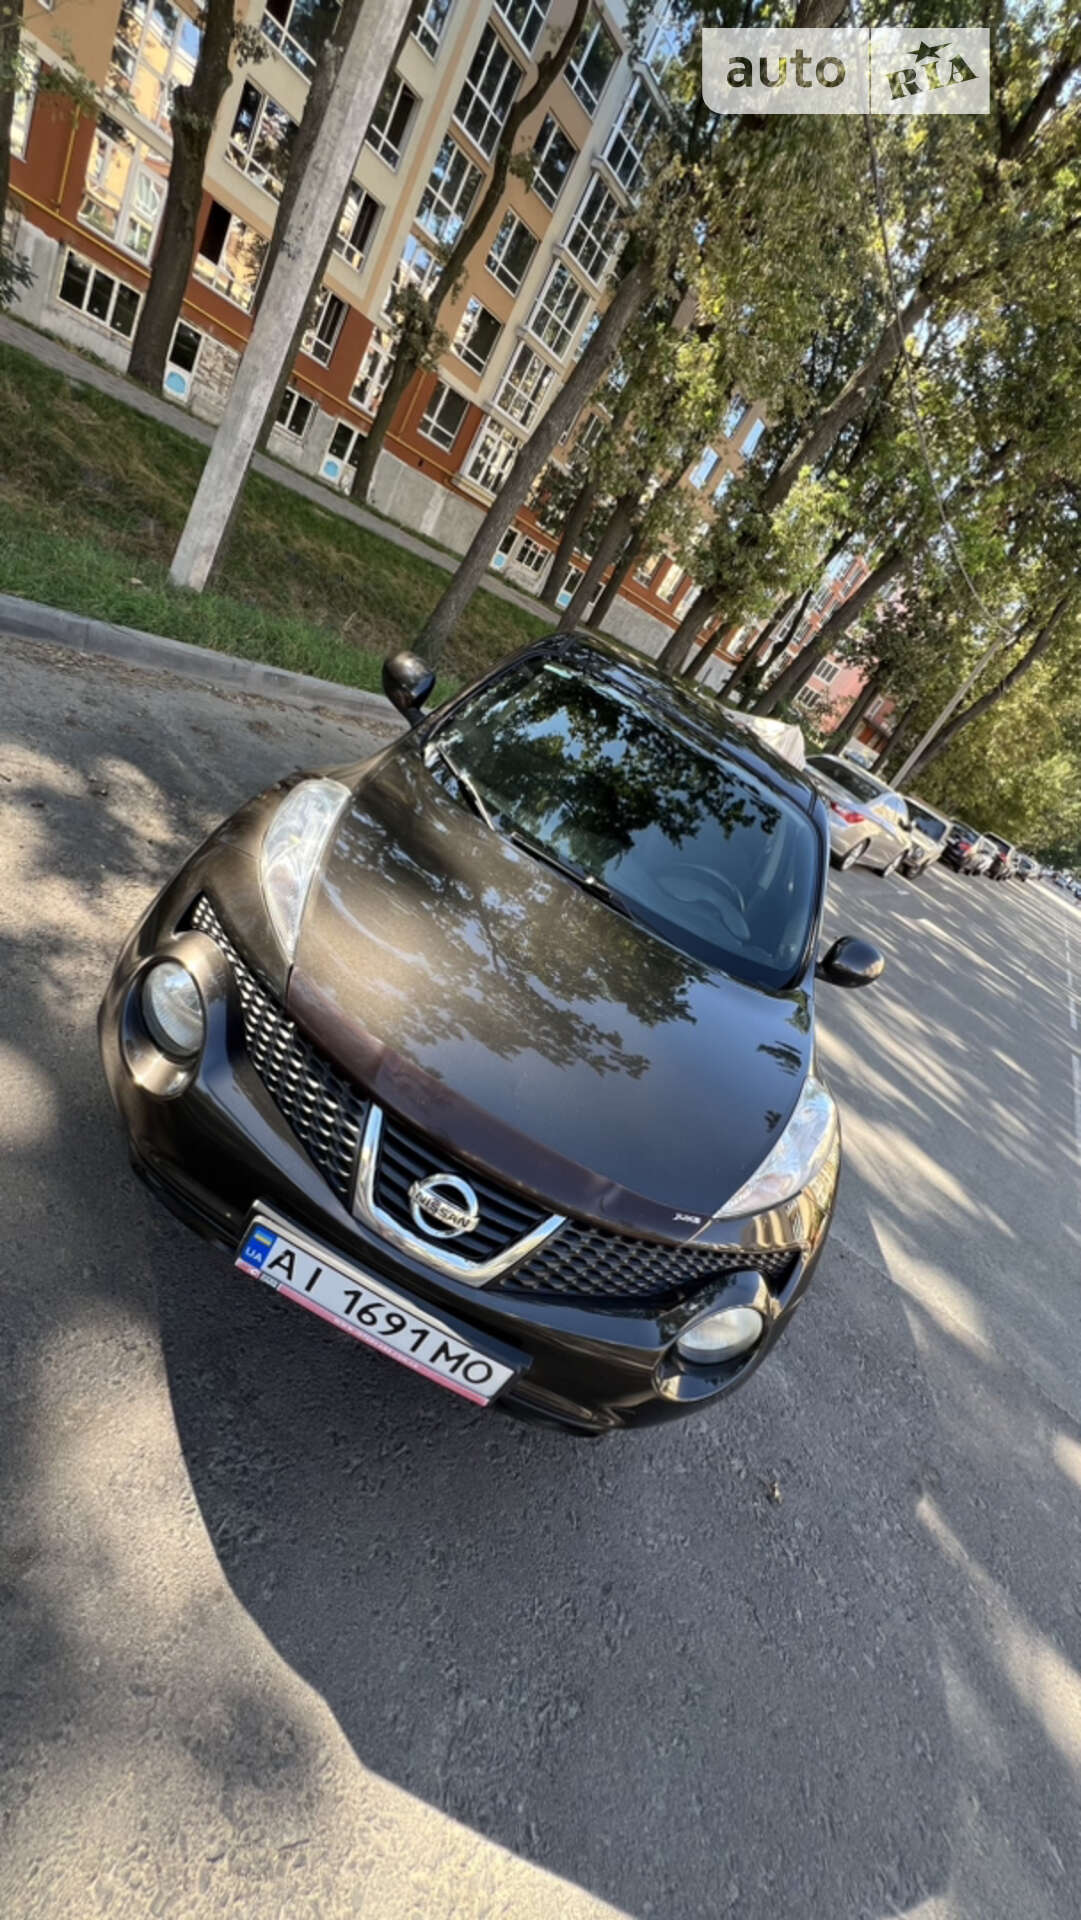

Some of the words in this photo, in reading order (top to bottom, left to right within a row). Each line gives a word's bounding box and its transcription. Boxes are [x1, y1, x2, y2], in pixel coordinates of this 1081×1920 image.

[414, 1190, 471, 1229] NISSAN
[244, 1246, 263, 1263] UA
[266, 1248, 323, 1293] AI
[343, 1289, 430, 1353] 1691
[428, 1340, 493, 1384] MO
